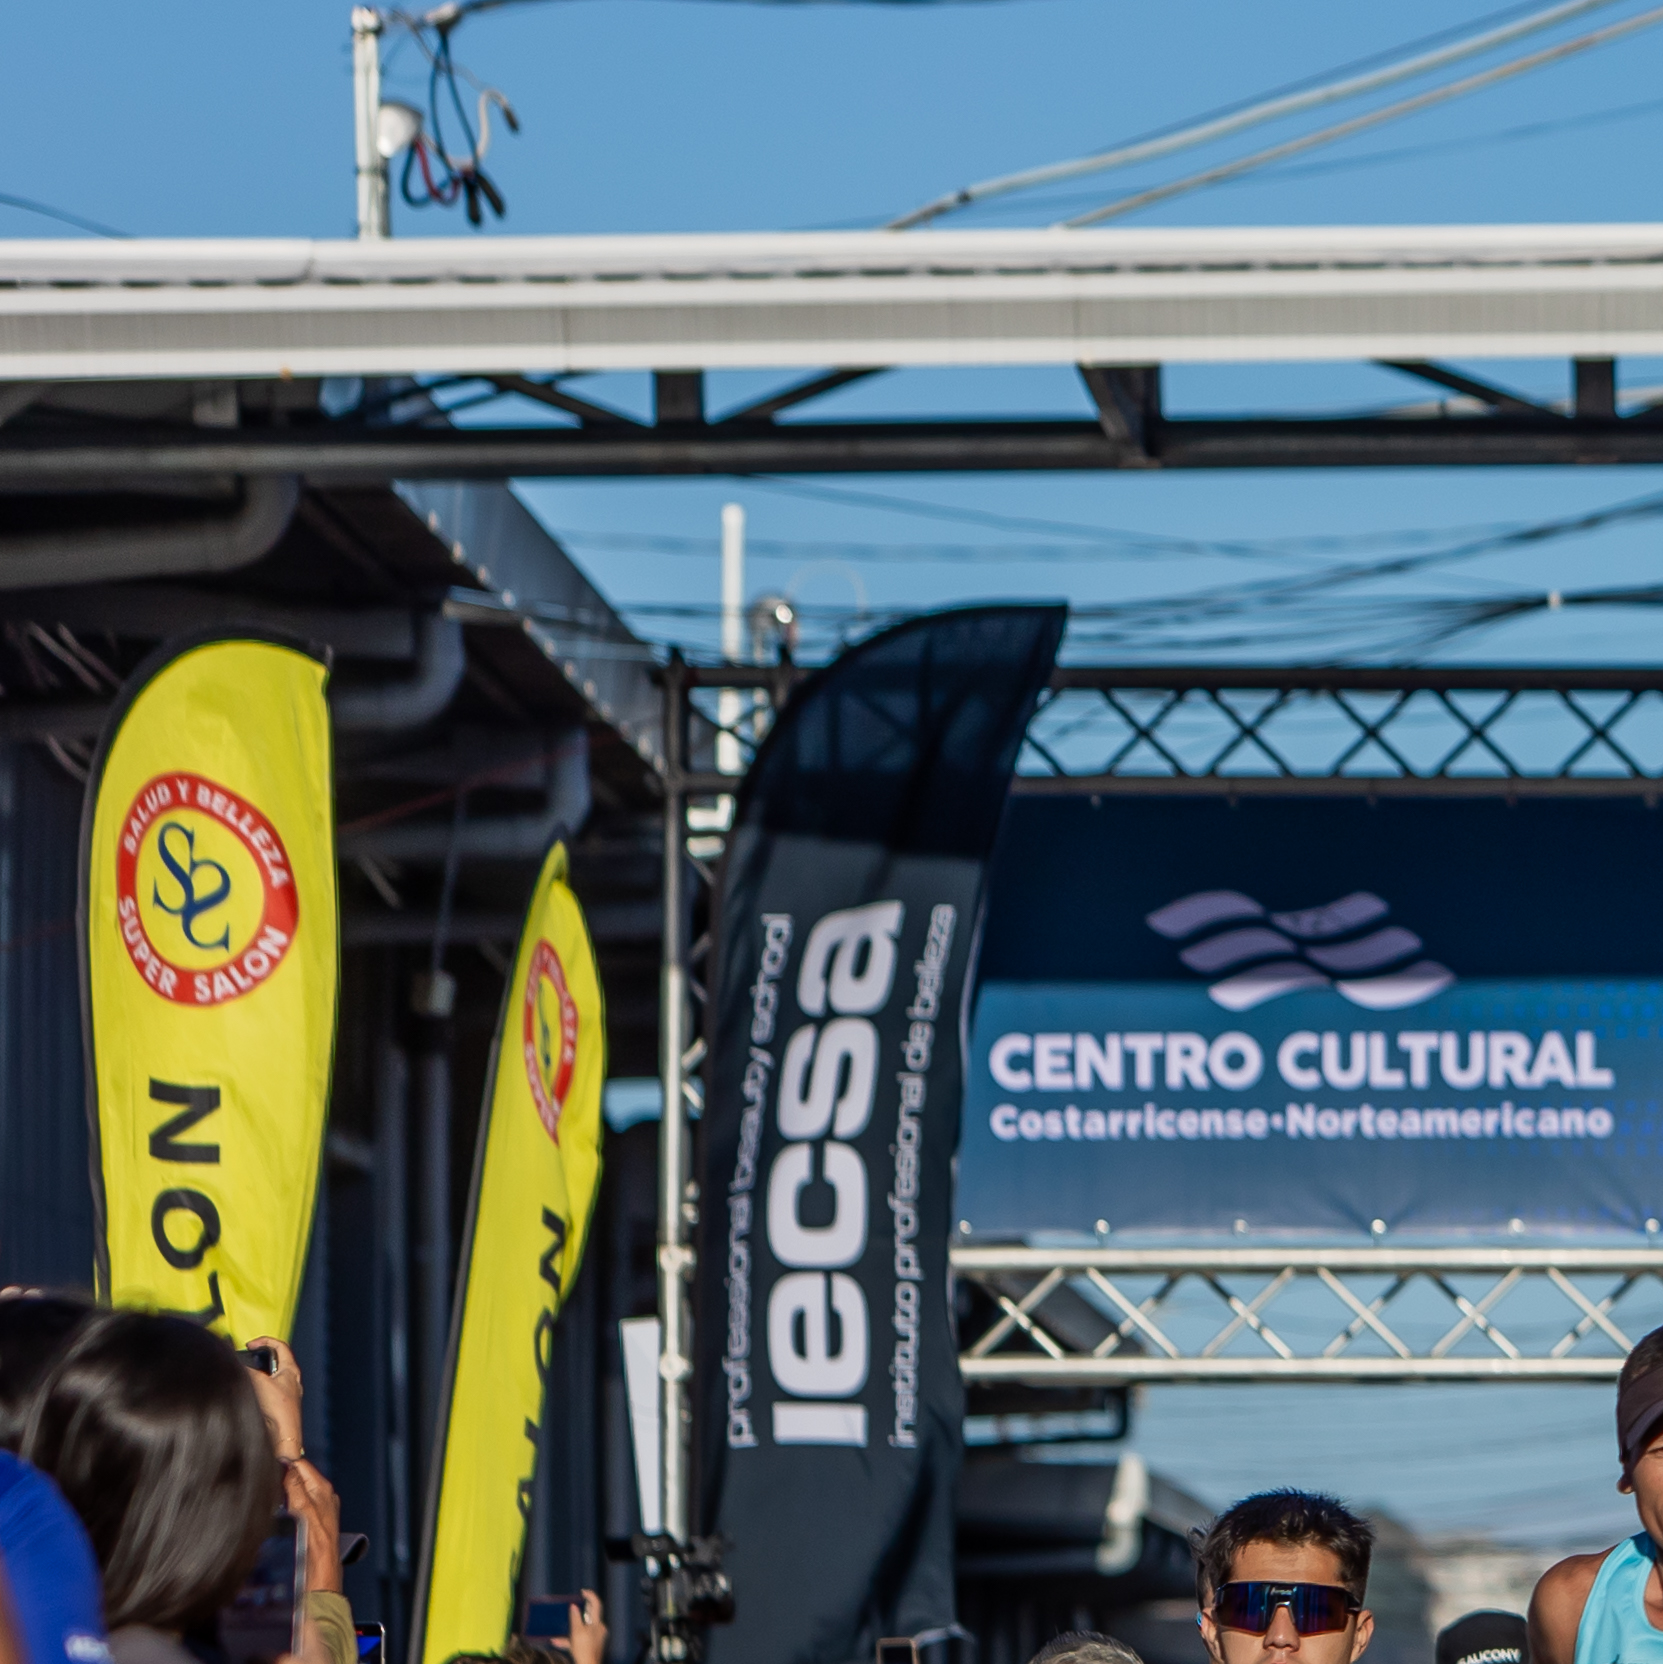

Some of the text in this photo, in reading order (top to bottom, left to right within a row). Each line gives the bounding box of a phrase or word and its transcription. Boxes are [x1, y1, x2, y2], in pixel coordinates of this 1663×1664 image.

[124, 777, 290, 890] SALUD Y BELLEZA
[118, 894, 289, 1003] SUPER SALON
[749, 911, 795, 1044] school
[906, 902, 959, 1021] belleza
[901, 1018, 936, 1072] de
[988, 1029, 1614, 1093] CENTRO CULTURAL
